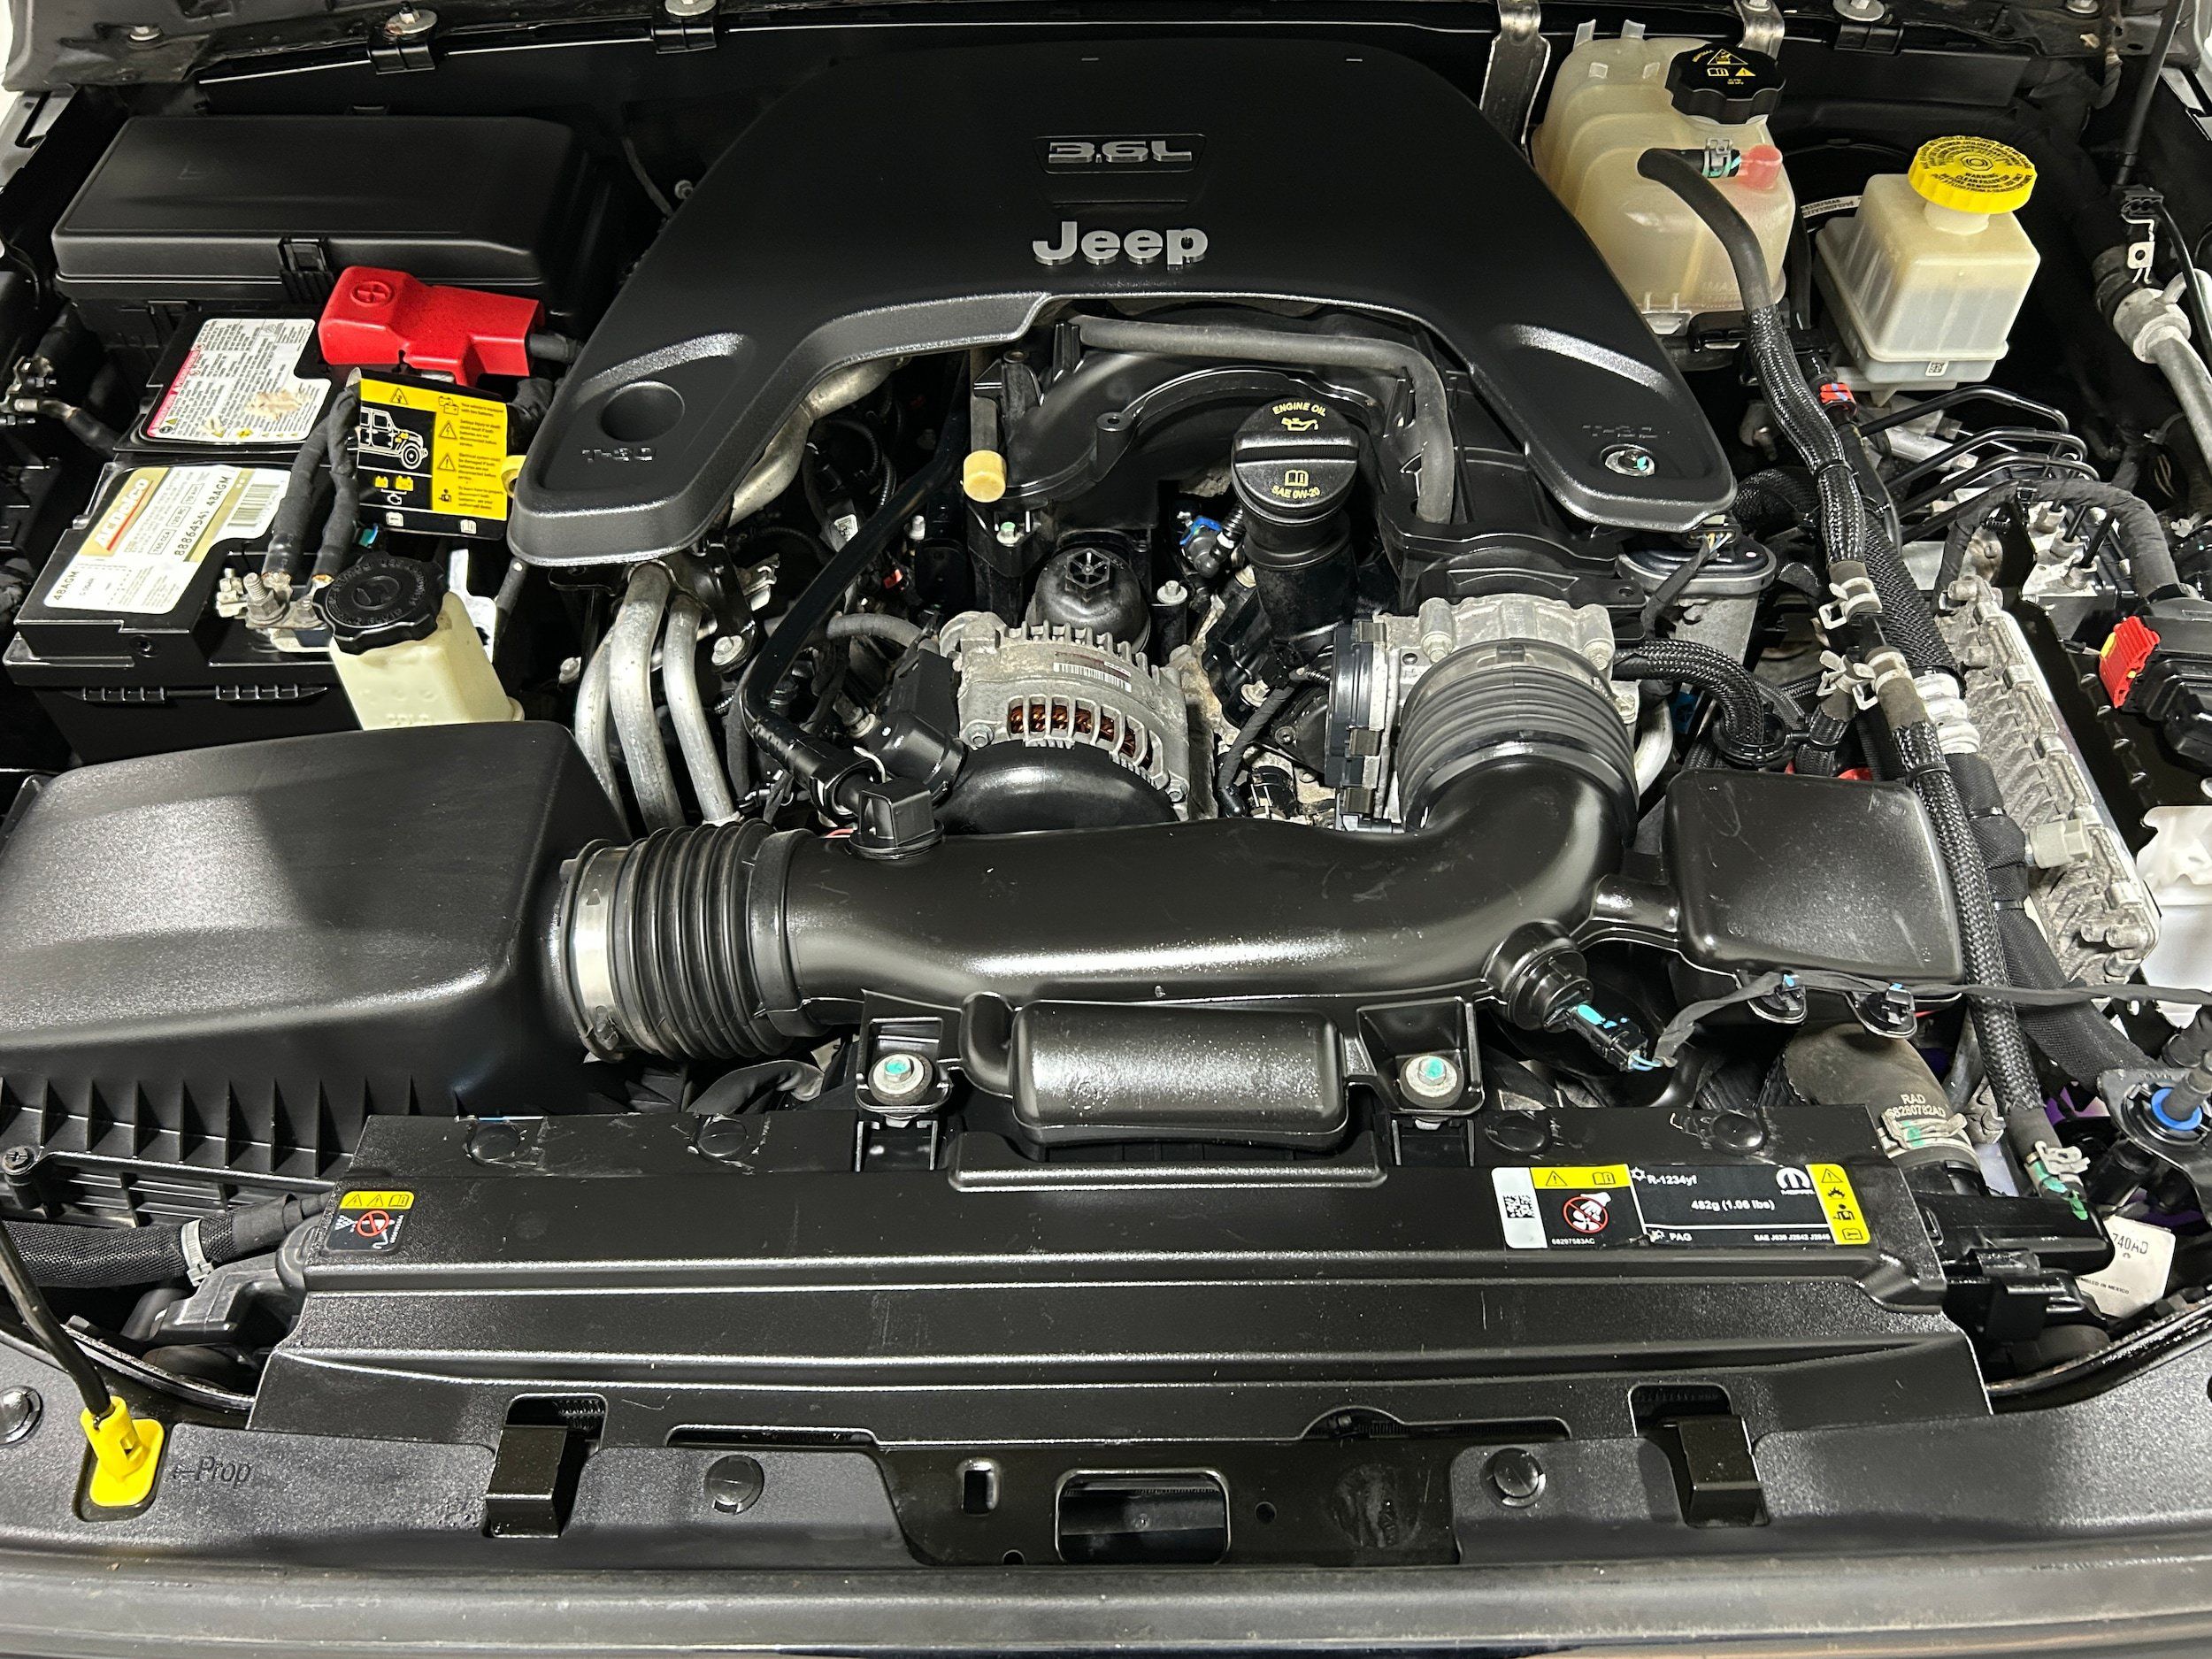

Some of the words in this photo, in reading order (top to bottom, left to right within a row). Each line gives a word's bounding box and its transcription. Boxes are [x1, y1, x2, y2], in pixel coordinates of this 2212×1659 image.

[1048, 140, 1192, 163] 3.6L
[1033, 221, 1209, 268] Jeep
[1271, 402, 1310, 415] ENGINE
[1310, 403, 1326, 417] OIL
[205, 475, 232, 509] 48AGM
[1271, 485, 1290, 498] SAE
[1293, 486, 1321, 499] 0W-20
[94, 478, 150, 550] ACDelco
[53, 571, 81, 602] 48AGM
[1901, 1094, 1926, 1104] RAD
[1647, 1174, 1698, 1187] R-1234yf
[1691, 1200, 1721, 1211] 482g
[1751, 1199, 1776, 1211] lbs)
[1669, 1232, 1693, 1242] PAG
[2108, 1285, 2130, 1294] MEXICO
[195, 1455, 250, 1489] Prop
